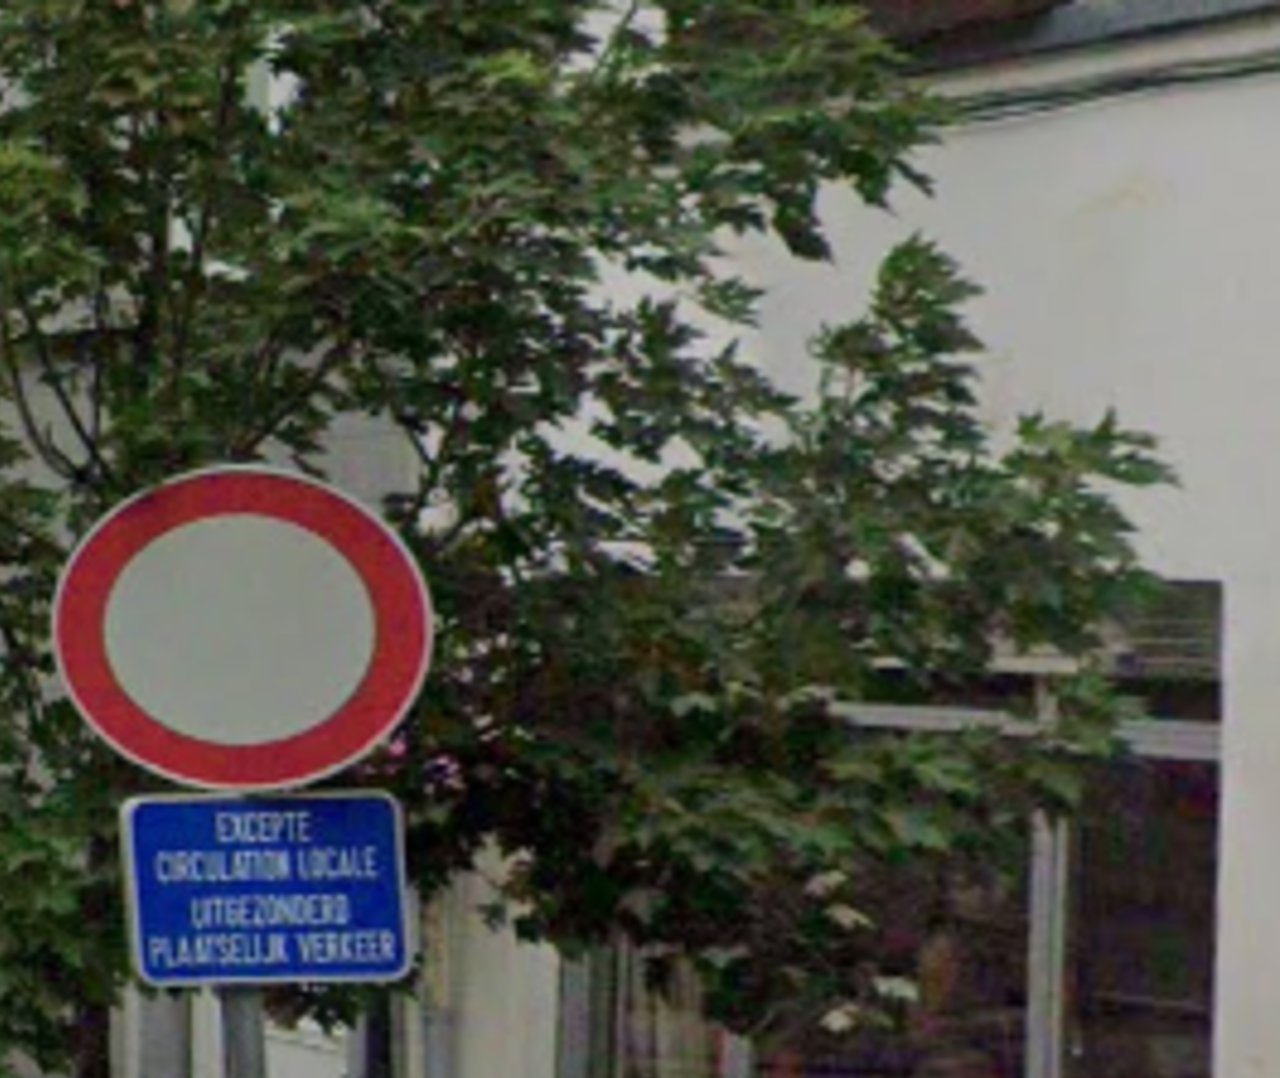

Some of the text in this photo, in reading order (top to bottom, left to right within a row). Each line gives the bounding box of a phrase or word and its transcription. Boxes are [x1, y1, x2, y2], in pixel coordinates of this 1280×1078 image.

[215, 812, 312, 843] EXCEPTE
[154, 846, 379, 882] CIRCULATION LOCALE
[191, 894, 350, 929] UITGEZONDERD
[149, 929, 395, 967] PLAATSELIJK VERKEER
